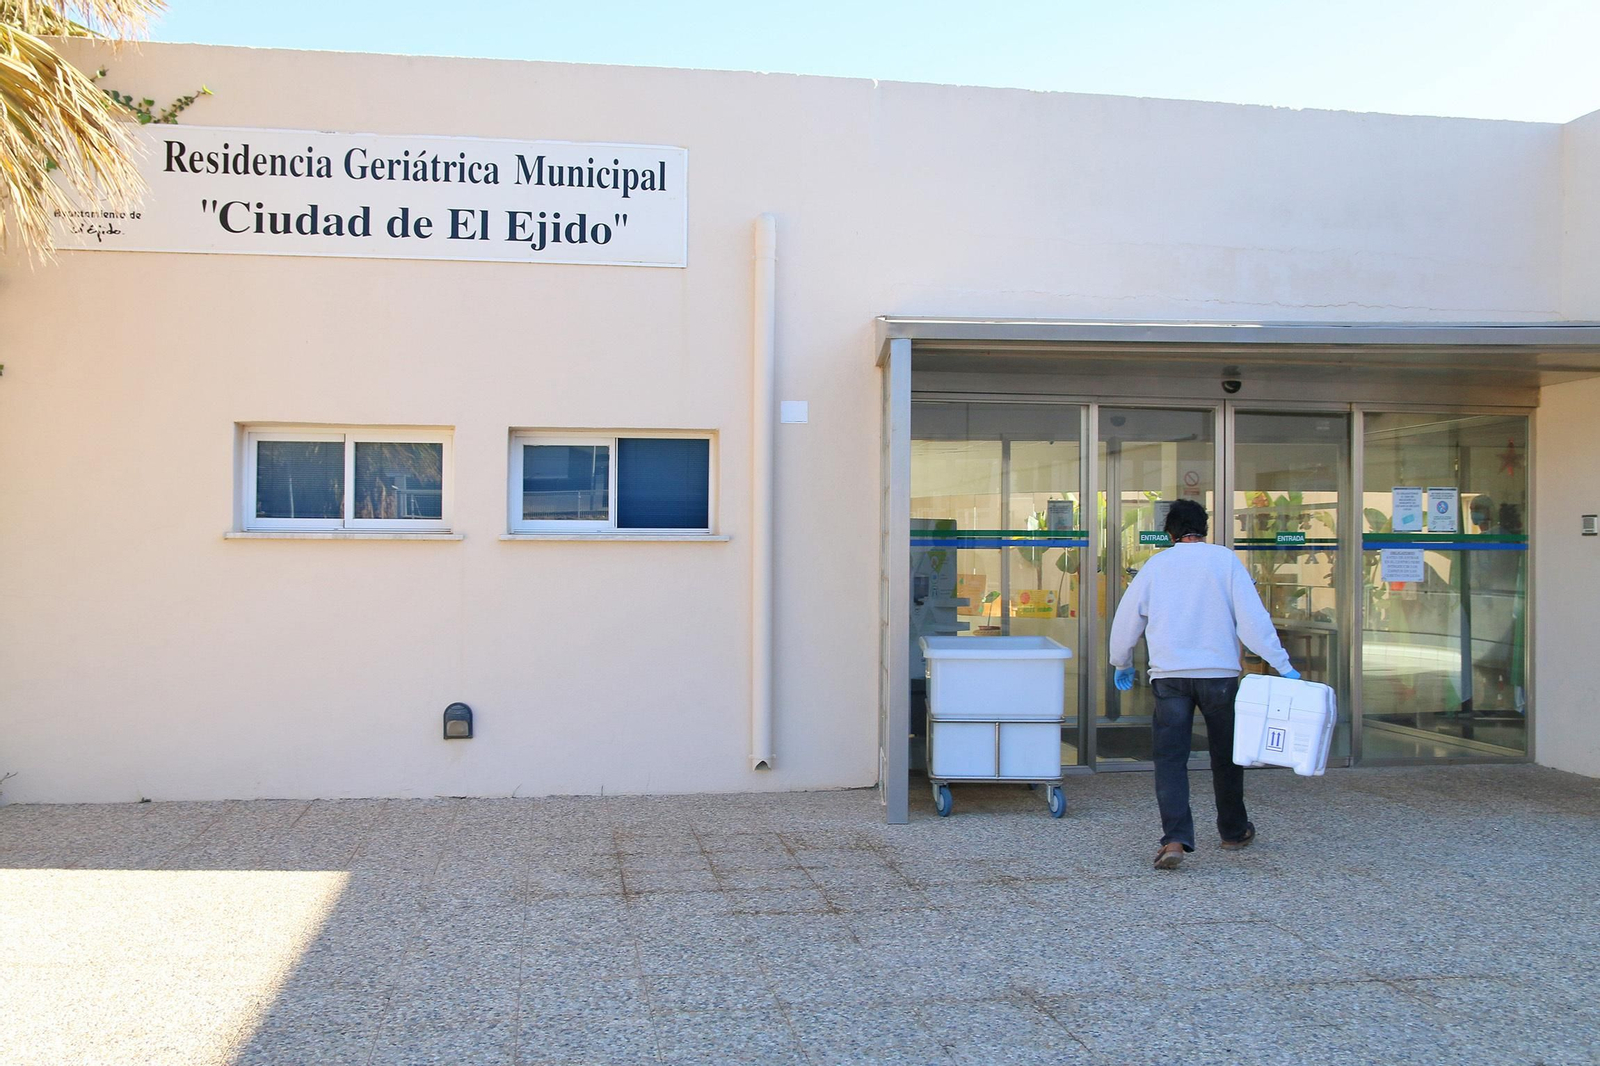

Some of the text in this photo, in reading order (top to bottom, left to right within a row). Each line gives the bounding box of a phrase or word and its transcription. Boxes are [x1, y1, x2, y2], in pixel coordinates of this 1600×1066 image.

[163, 139, 667, 199] Residencia Geriátrica Municipal
[129, 211, 142, 220] de
[201, 198, 629, 252] "Ciudad de El Ejido"
[1140, 534, 1169, 542] ENTRADA
